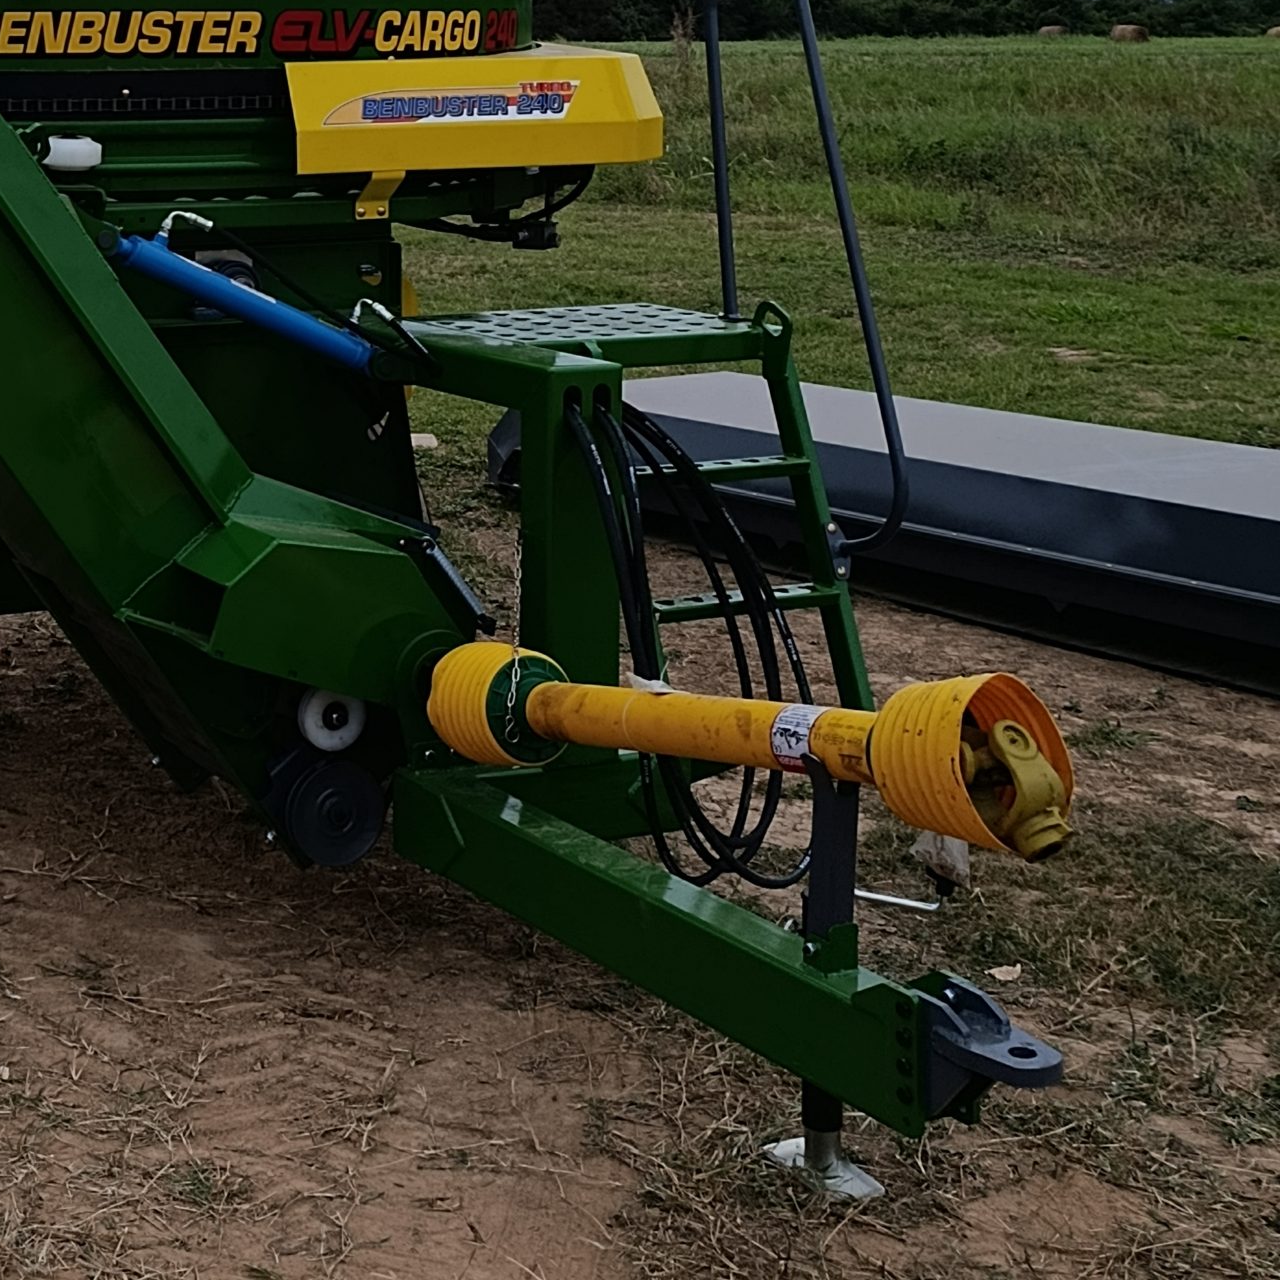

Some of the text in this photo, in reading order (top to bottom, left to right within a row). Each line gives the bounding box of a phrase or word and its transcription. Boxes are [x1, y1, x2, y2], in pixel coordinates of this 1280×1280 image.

[484, 9, 518, 50] 240
[519, 82, 572, 93] TURBO
[361, 92, 565, 119] BENBUSTER 240
